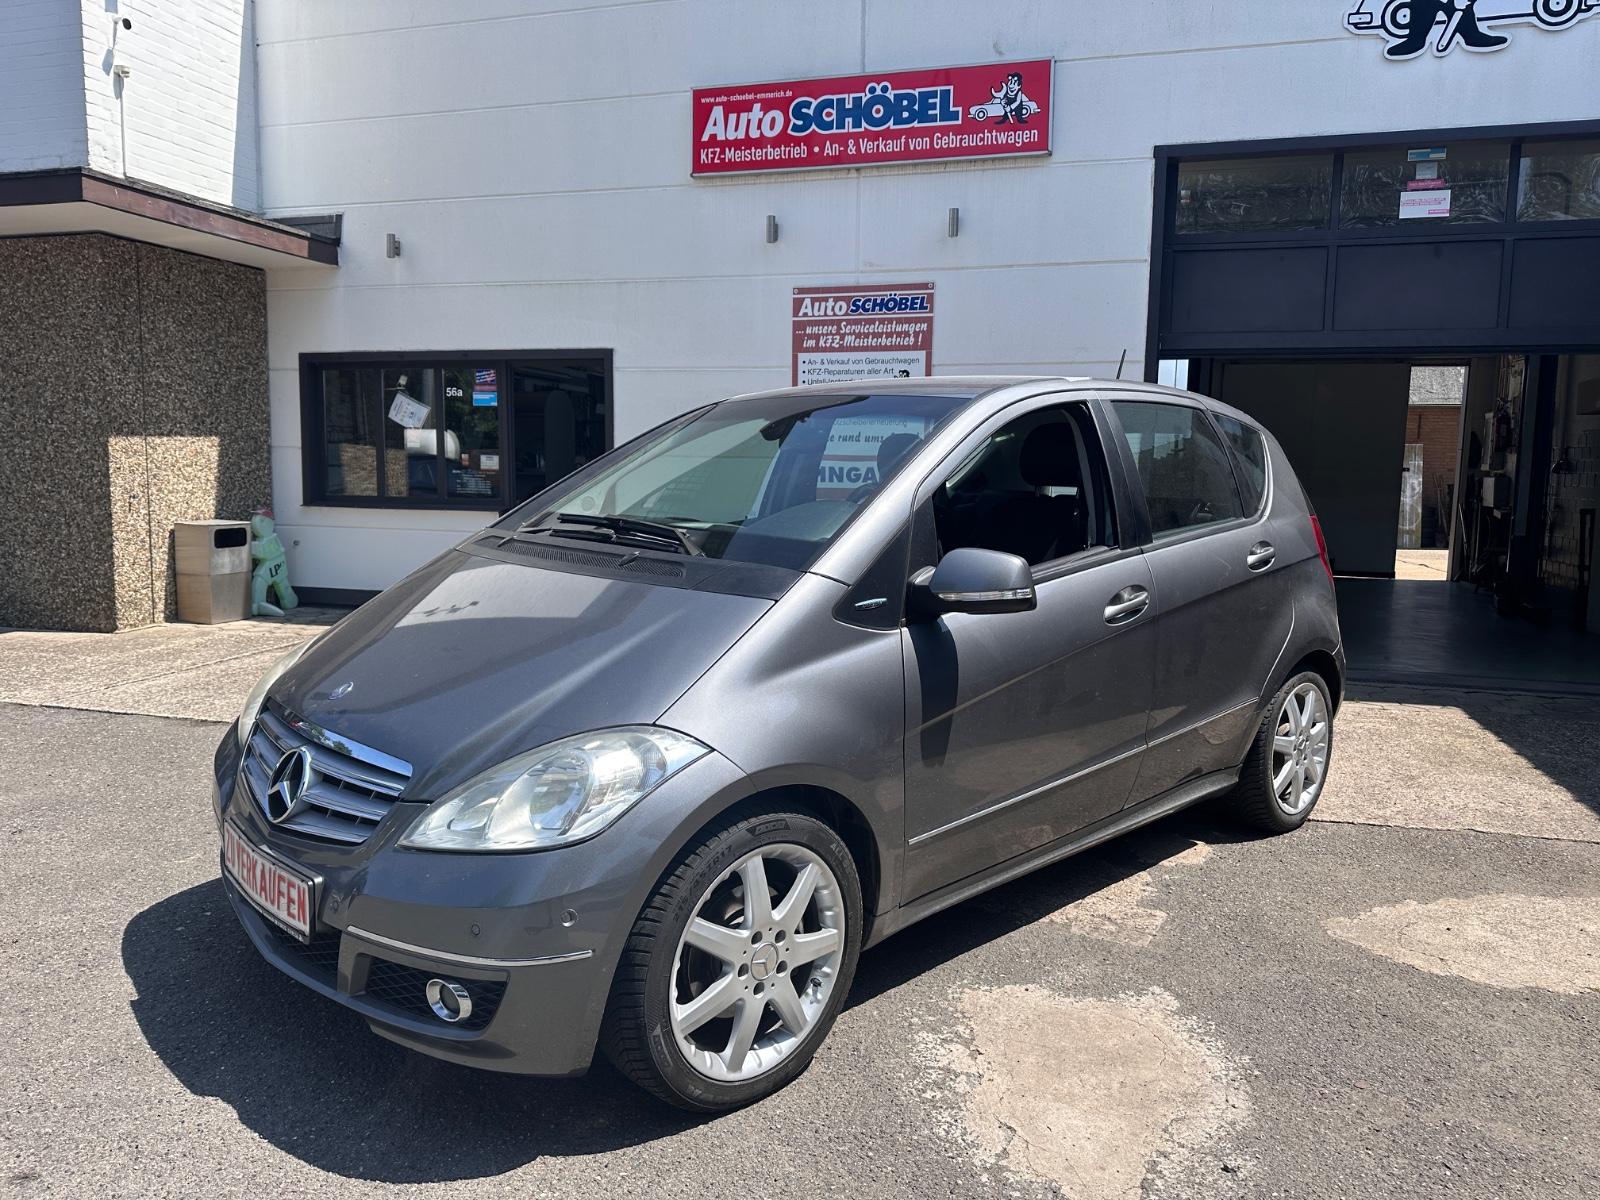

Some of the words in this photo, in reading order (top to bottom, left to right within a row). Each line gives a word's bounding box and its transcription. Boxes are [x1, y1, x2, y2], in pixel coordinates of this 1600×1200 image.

[700, 102, 785, 141] Auto
[787, 81, 962, 136] SCHÖBEL
[700, 142, 808, 164] KFZ-Meisterbetrieb
[824, 140, 844, 156] An-
[848, 139, 856, 155] &
[860, 135, 906, 154] Verkauf
[908, 136, 930, 151] von
[933, 129, 1038, 149] Gebrauchtwagen
[798, 297, 847, 317] Auto
[849, 293, 930, 314] SCHÖBEL
[840, 320, 928, 335] Serviceleistungen
[803, 336, 816, 348] im
[818, 334, 914, 348] KFZ-Meisterbetrieb
[826, 357, 850, 366] Verkauf
[864, 356, 920, 367] Gebrauchtwagen
[807, 368, 865, 377] KFZ-Reparaturen
[883, 367, 894, 375] Art
[446, 387, 463, 397] 56a
[837, 432, 861, 443] rund
[819, 466, 878, 483] INGA
[226, 828, 236, 868] ZU
[236, 838, 307, 926] VERKAUFEN
